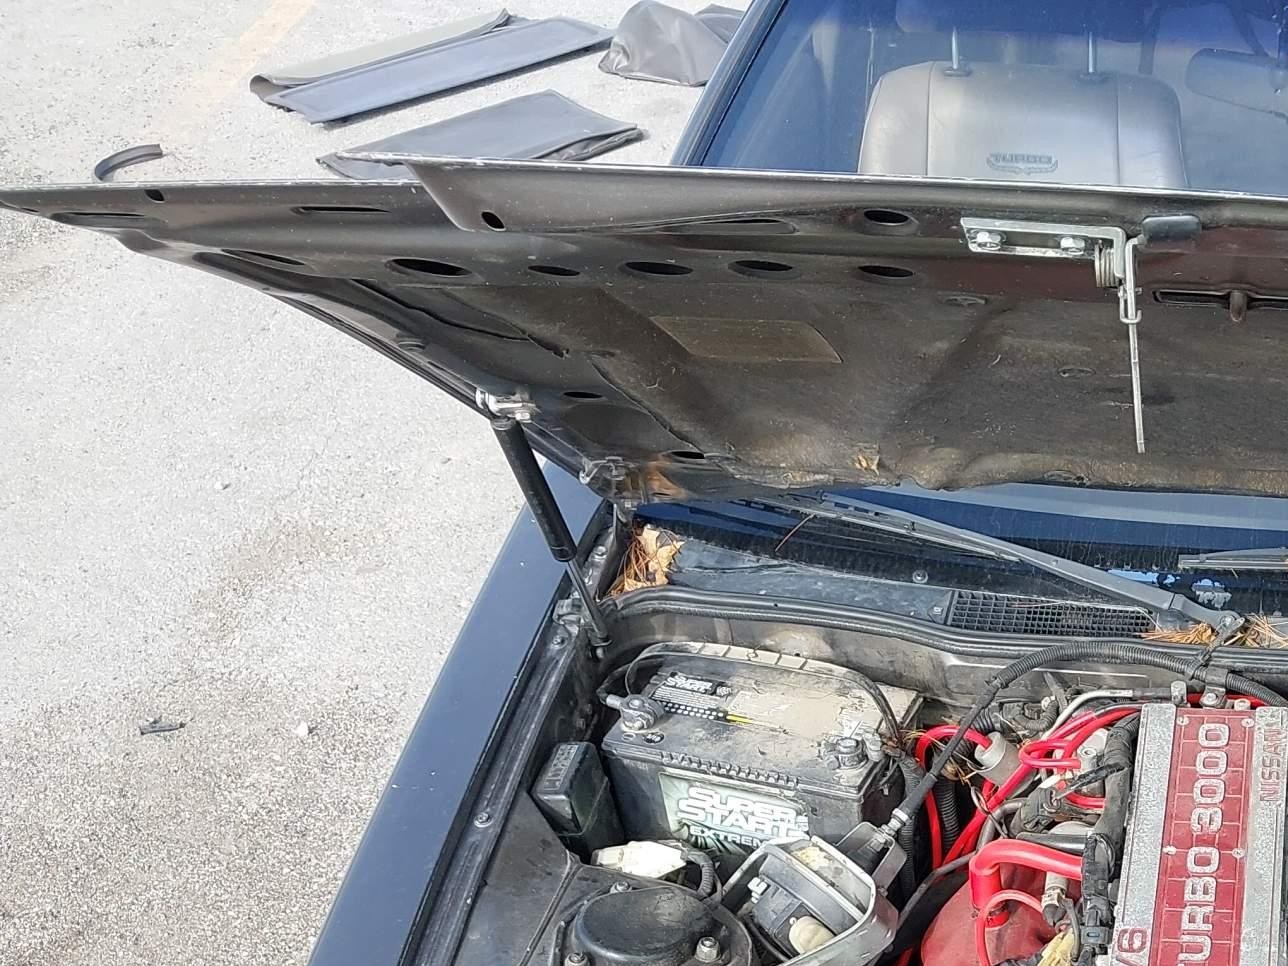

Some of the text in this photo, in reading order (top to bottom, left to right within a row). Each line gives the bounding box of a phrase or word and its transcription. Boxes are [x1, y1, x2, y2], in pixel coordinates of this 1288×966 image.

[1190, 722, 1230, 833] 3000
[1259, 728, 1282, 802] NISSAN
[677, 799, 803, 839] START
[687, 786, 798, 822] SUPER
[690, 825, 767, 848] EXTREM
